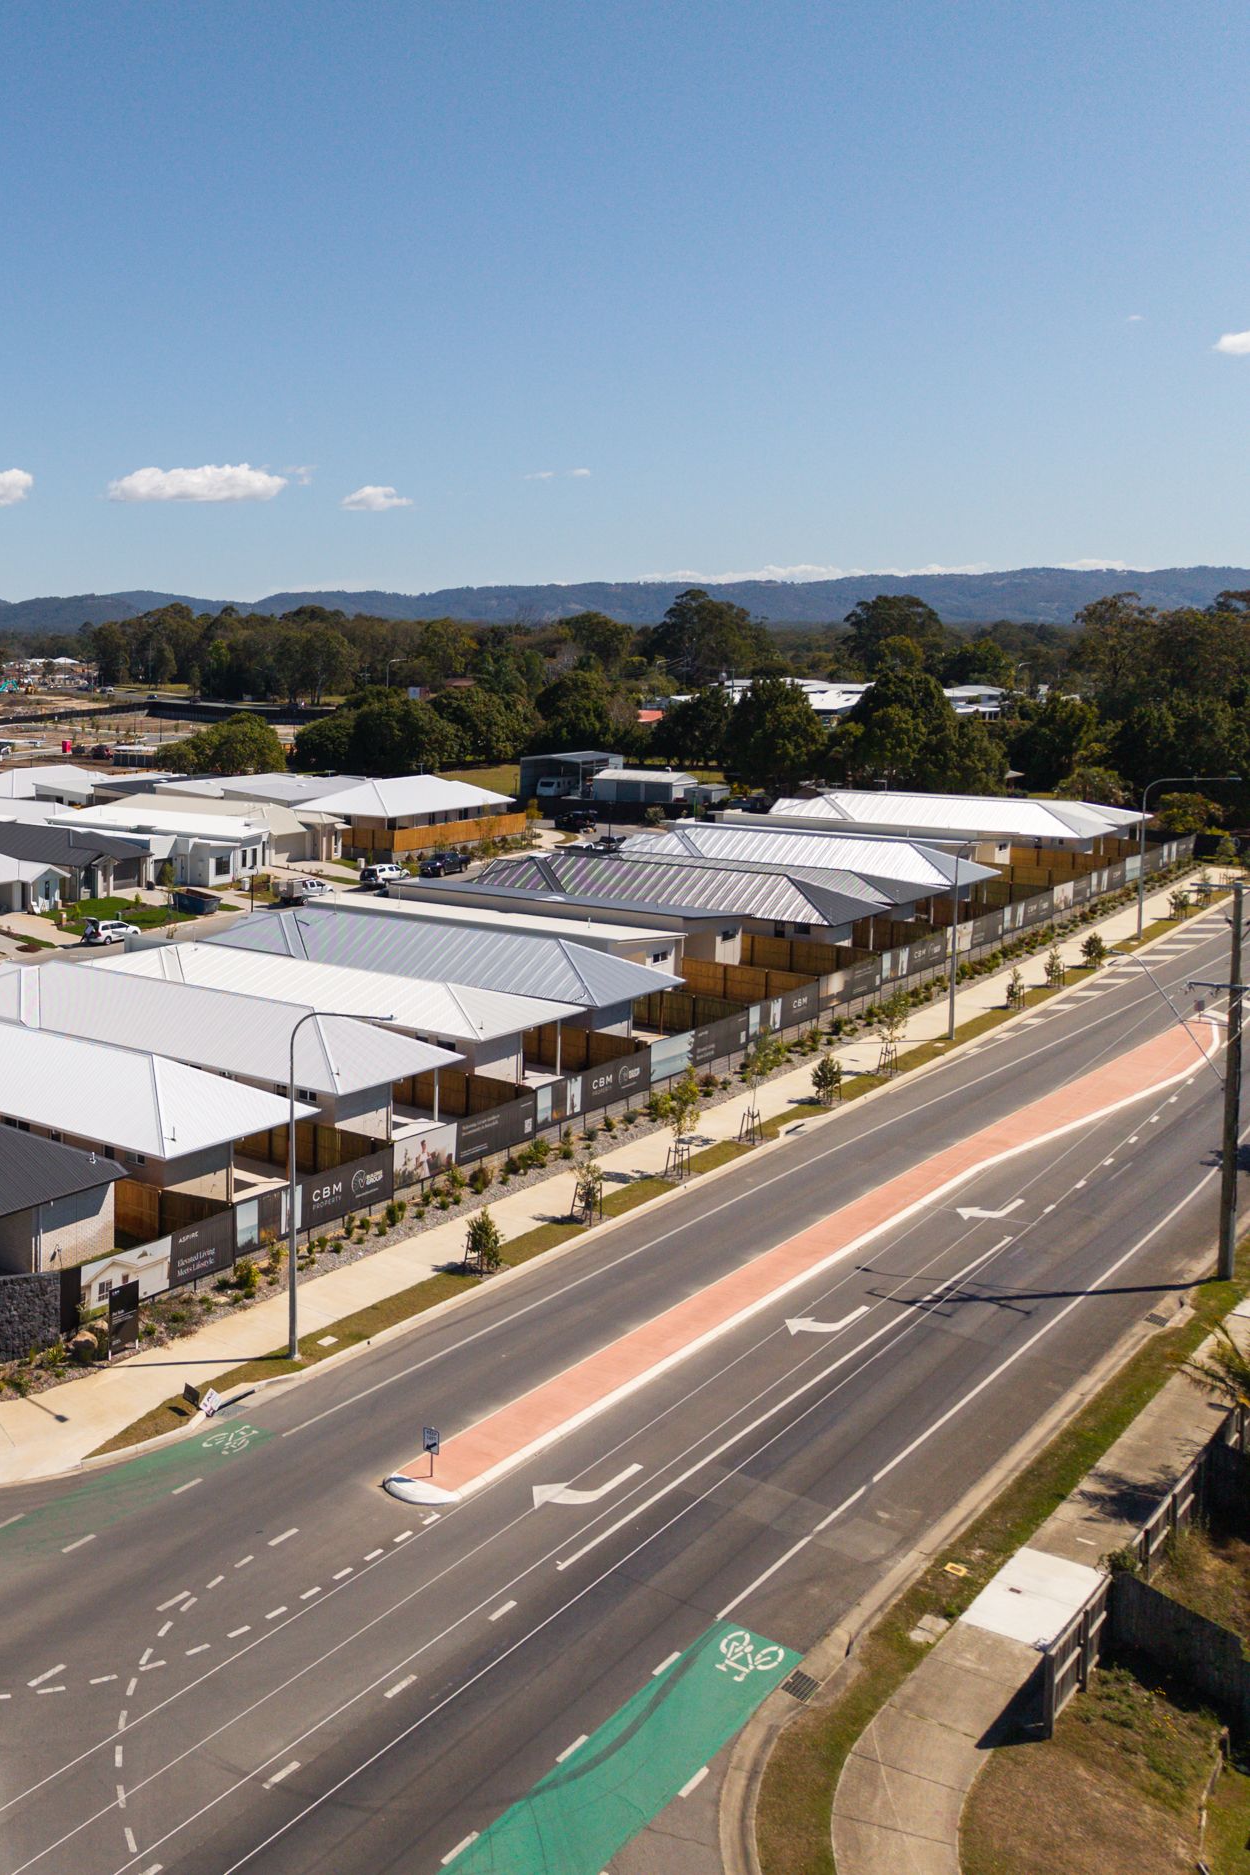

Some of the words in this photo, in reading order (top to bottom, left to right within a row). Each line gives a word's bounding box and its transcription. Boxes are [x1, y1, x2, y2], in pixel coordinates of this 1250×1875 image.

[592, 1074, 613, 1090] CBM
[312, 1181, 342, 1202] CBM
[312, 1195, 342, 1211] PROPERTY
[178, 1231, 199, 1243] ASPIRE
[177, 1252, 199, 1267] Elevated
[199, 1247, 216, 1260] Living
[177, 1266, 193, 1278] Meets
